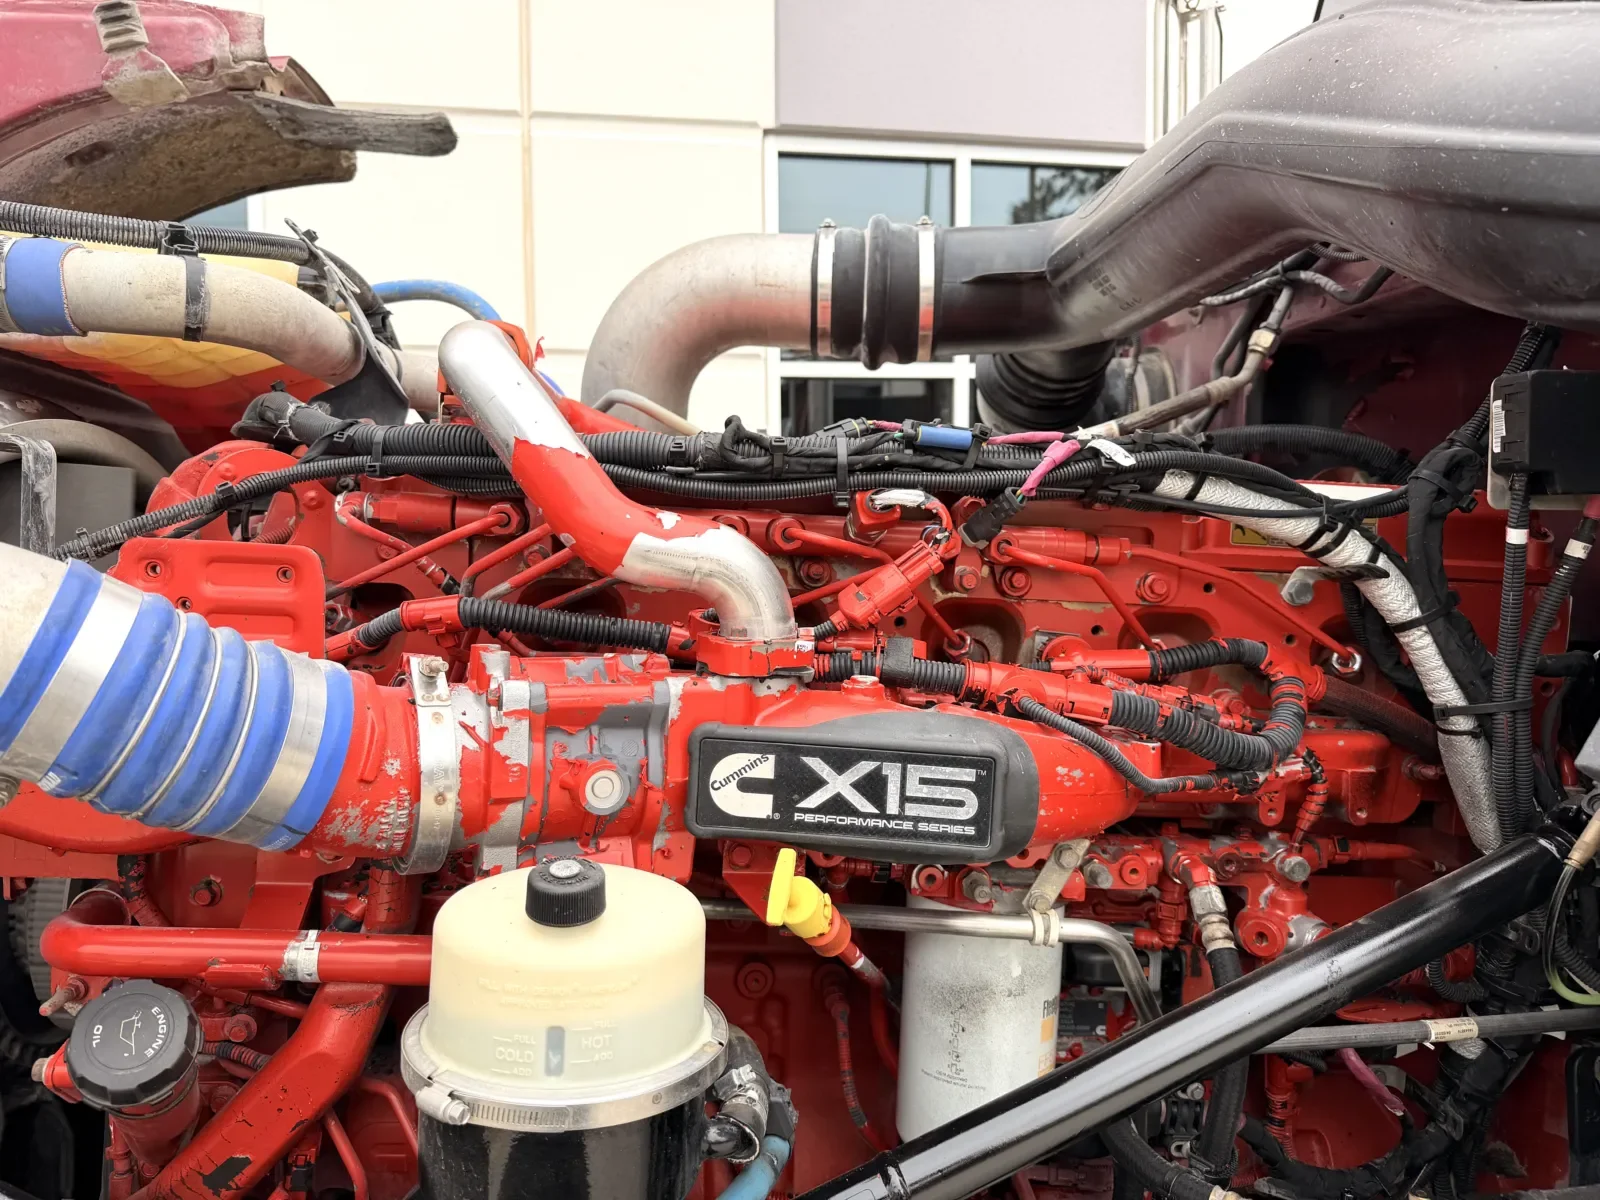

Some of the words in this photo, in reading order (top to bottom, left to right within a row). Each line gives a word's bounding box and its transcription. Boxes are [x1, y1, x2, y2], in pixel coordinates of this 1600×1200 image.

[710, 754, 769, 791] Cummins
[795, 756, 979, 820] X15
[794, 812, 914, 830] PERFORMANCE
[917, 822, 976, 835] SERIES
[92, 1024, 103, 1048] OIL
[143, 1006, 167, 1058] ENGINE
[513, 1034, 537, 1045] FULL
[581, 1034, 613, 1050] HOT
[495, 1047, 534, 1063] COLD
[512, 1068, 532, 1077] ADD
